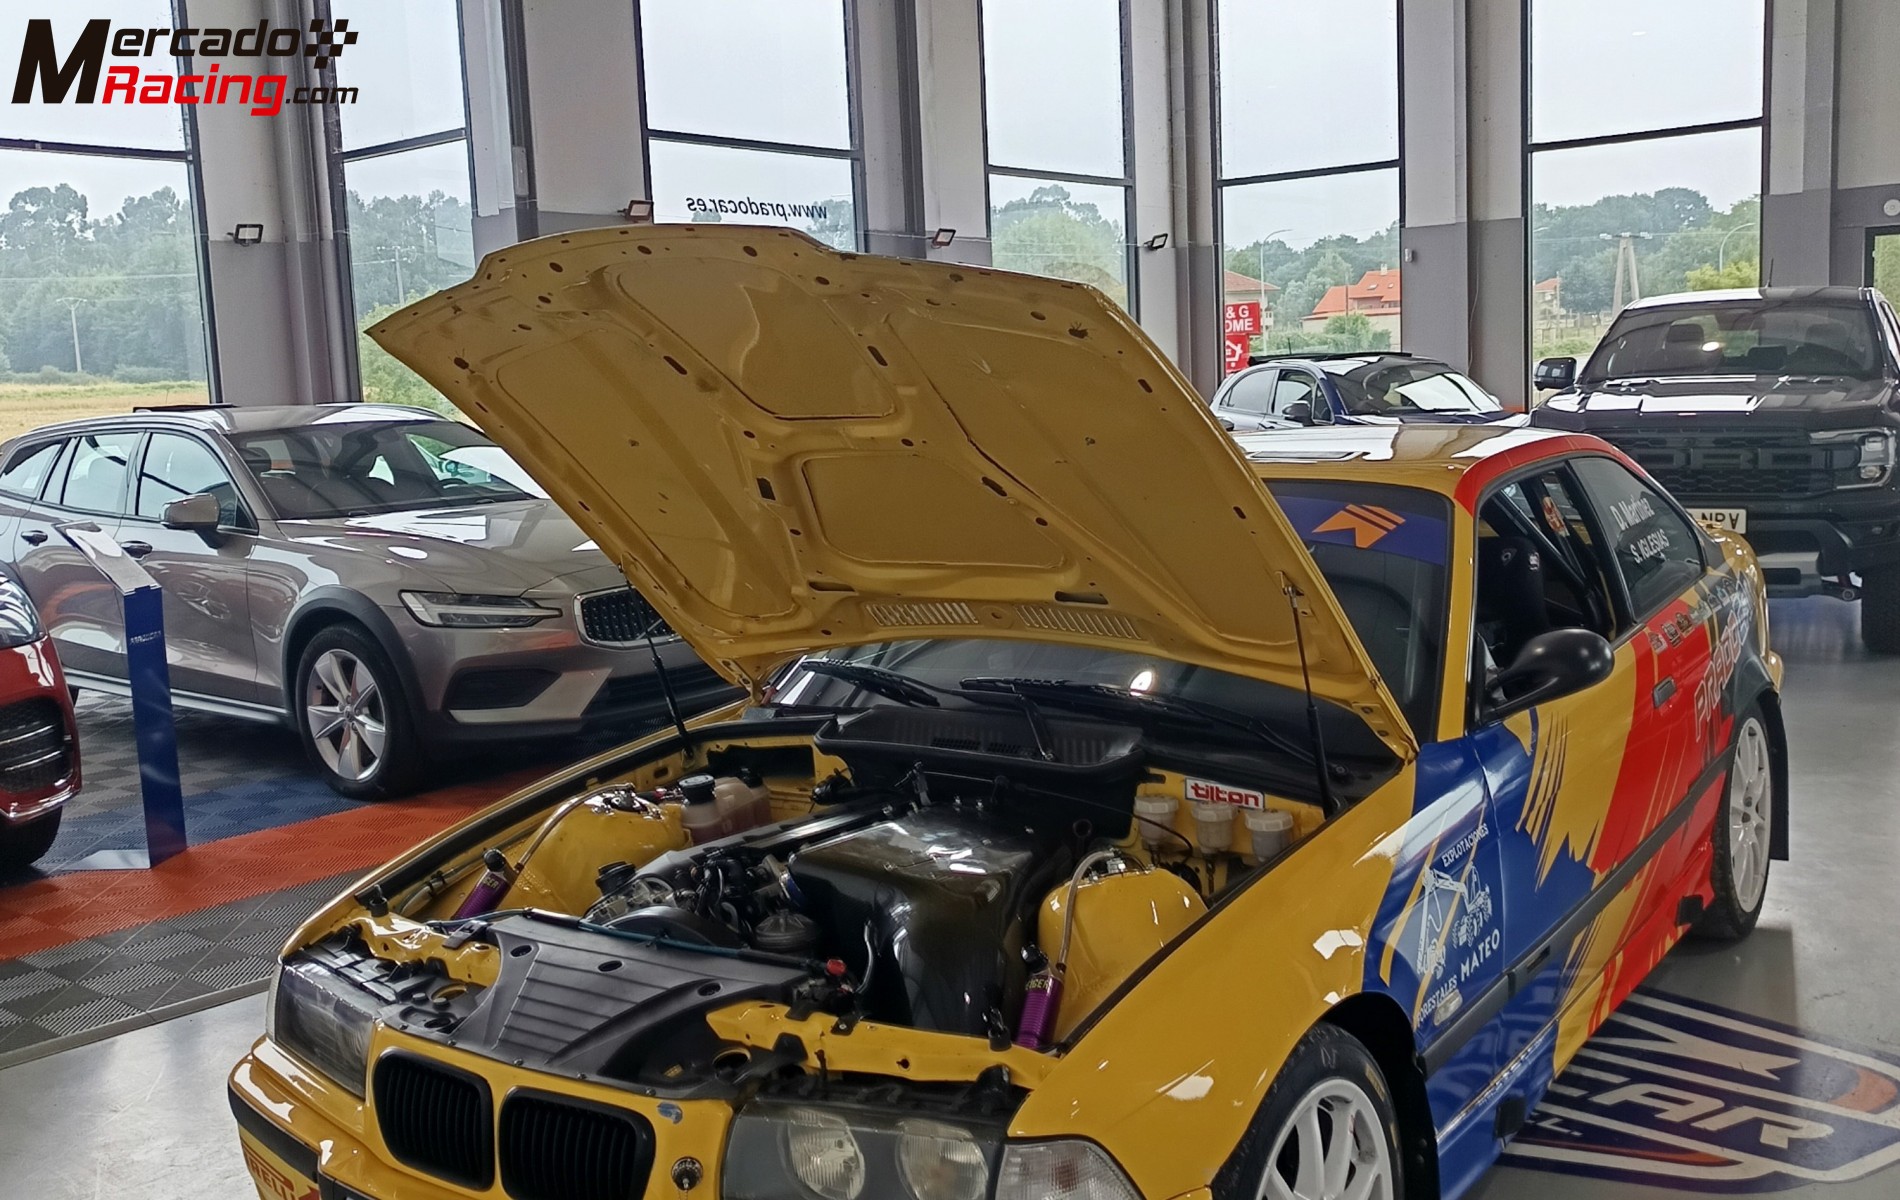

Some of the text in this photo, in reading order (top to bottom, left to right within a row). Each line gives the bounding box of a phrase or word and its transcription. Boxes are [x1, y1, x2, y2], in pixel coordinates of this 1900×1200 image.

[1239, 305, 1250, 318] G
[1225, 318, 1254, 333] OME
[1633, 447, 1825, 470] ORD
[1637, 528, 1670, 560] IGLESIAS
[1190, 782, 1260, 807] tilton
[1442, 822, 1489, 868] EXPLOTACIONES
[1416, 928, 1500, 1028] FORESTALES MATEO
